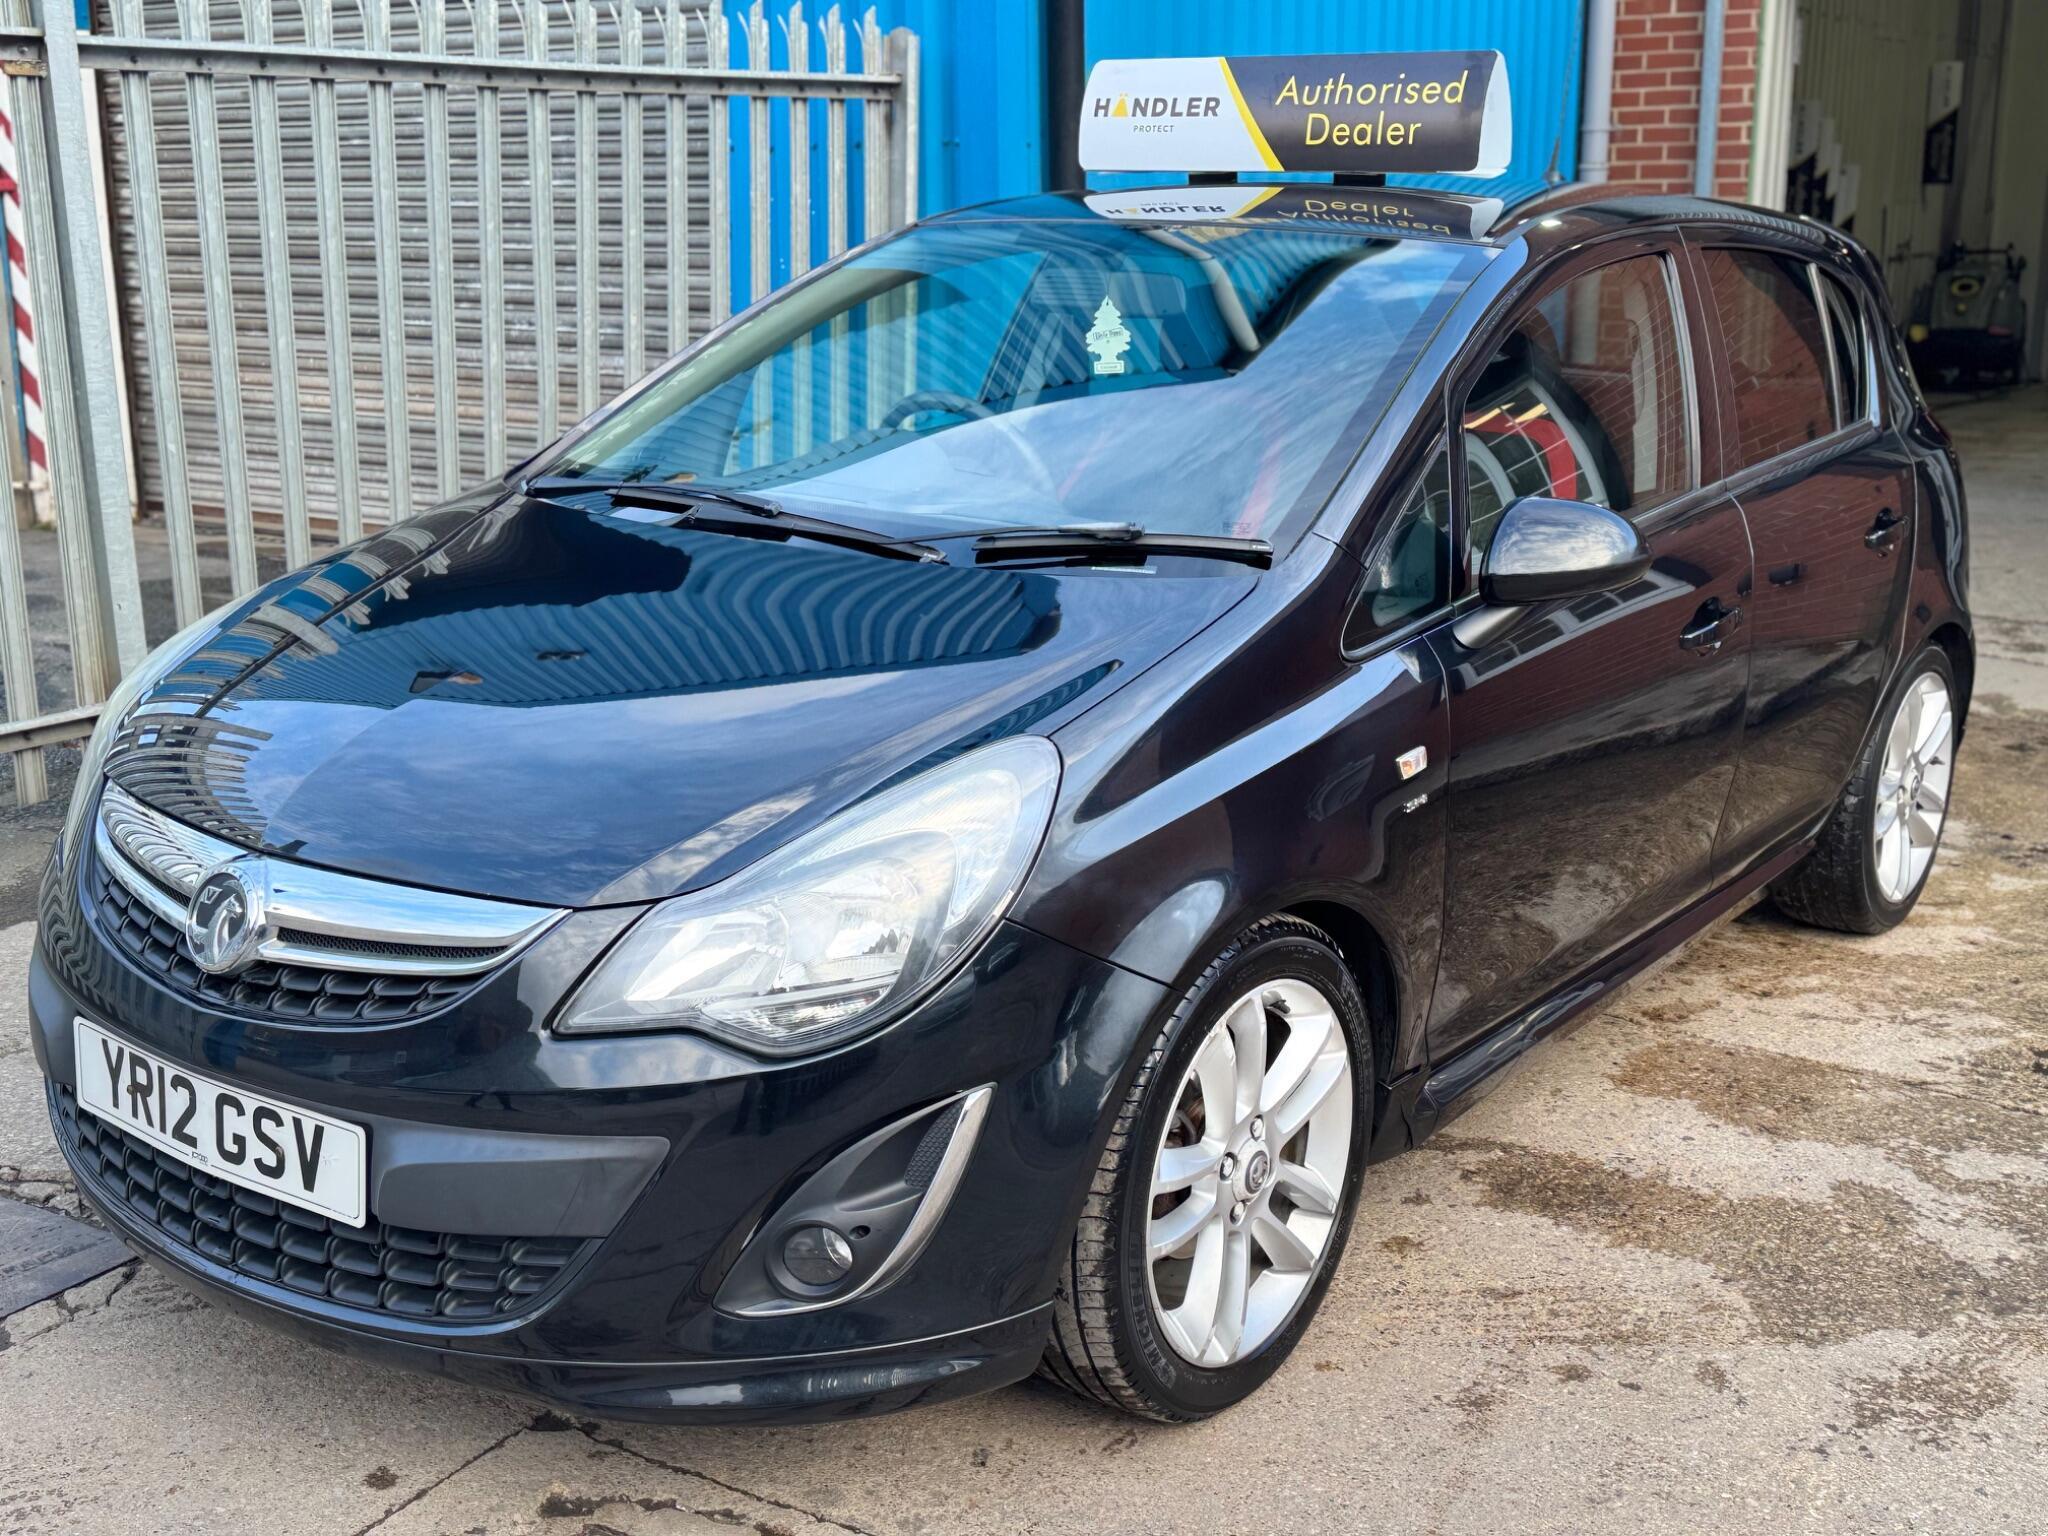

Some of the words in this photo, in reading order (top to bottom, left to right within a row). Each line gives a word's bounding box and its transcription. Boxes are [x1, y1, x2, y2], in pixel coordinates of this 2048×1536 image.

[1275, 70, 1469, 106] Authorised
[1133, 124, 1175, 134] PROTECT
[1305, 110, 1422, 146] Dealer
[101, 1037, 198, 1150] YR12
[214, 1091, 325, 1194] GSV
